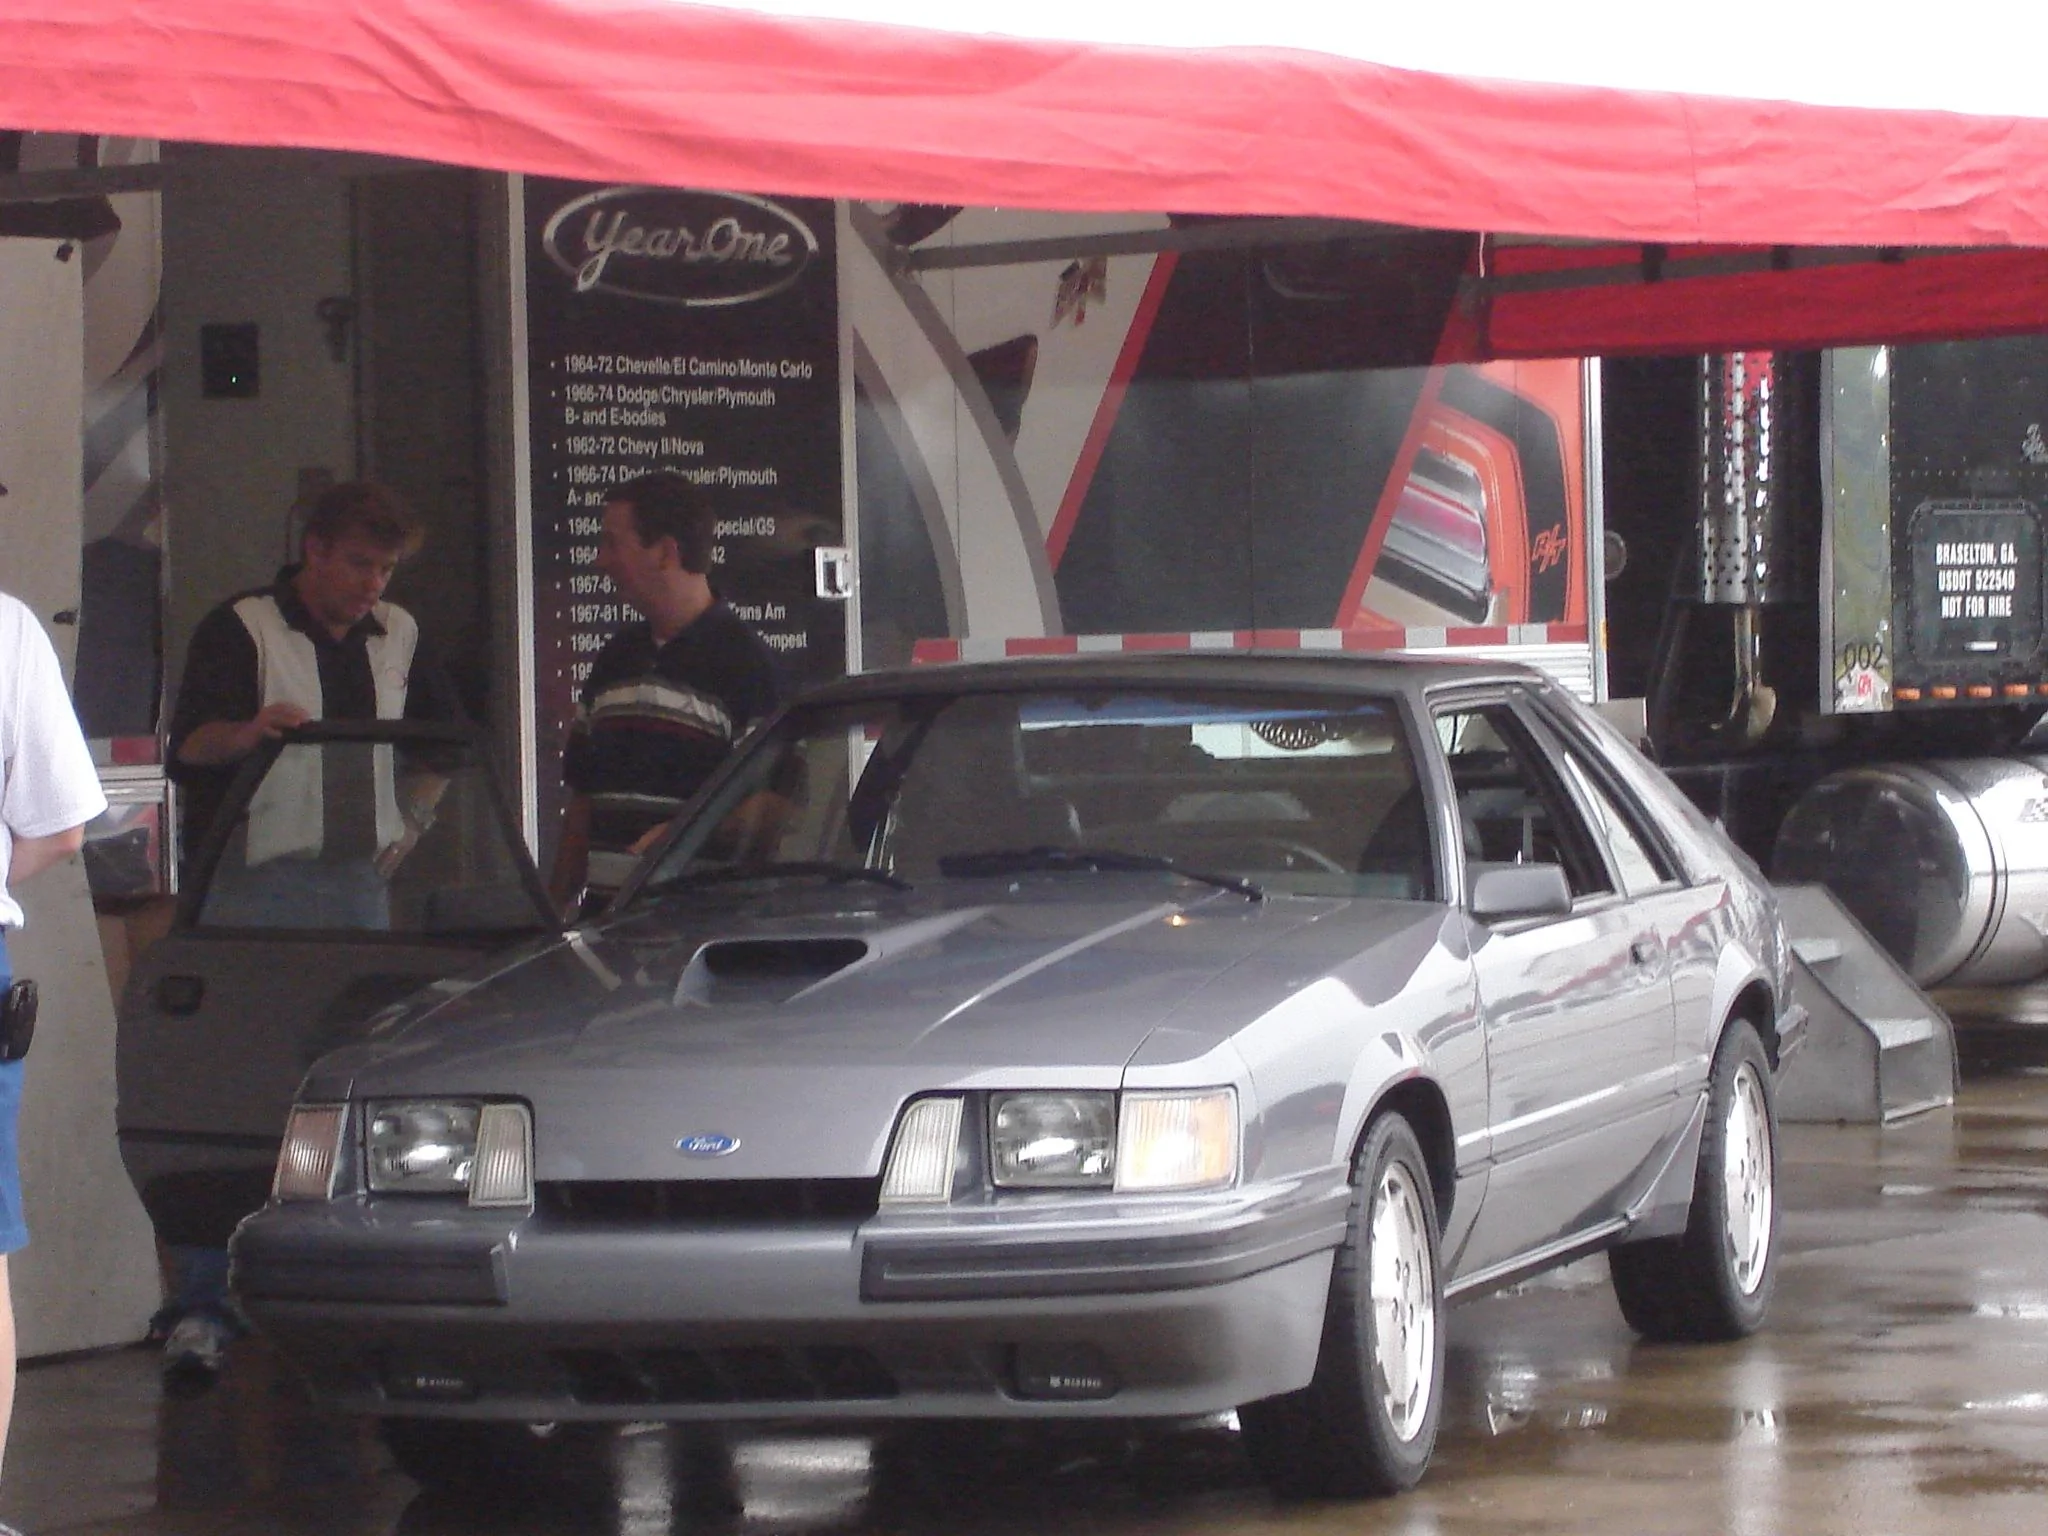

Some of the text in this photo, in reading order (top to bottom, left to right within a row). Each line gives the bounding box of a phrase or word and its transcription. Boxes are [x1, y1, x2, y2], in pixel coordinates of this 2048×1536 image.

[564, 354, 613, 374] 1964-72
[780, 359, 813, 379] Carlo
[565, 406, 667, 427] B- and E-bodies
[567, 436, 616, 456] 1962-72
[618, 436, 659, 459] Chevy
[567, 464, 617, 483] 1966-74
[567, 487, 582, 506] A-
[569, 516, 776, 540] 1964- pecial/GS
[1936, 542, 2019, 567] BRASELTON, GA.
[1938, 568, 2015, 592] USDOT 522540
[571, 604, 619, 623] 1967-81
[764, 601, 786, 620] Am
[1941, 594, 2012, 619] NOT FOR HIRE
[572, 633, 613, 652] 1964-
